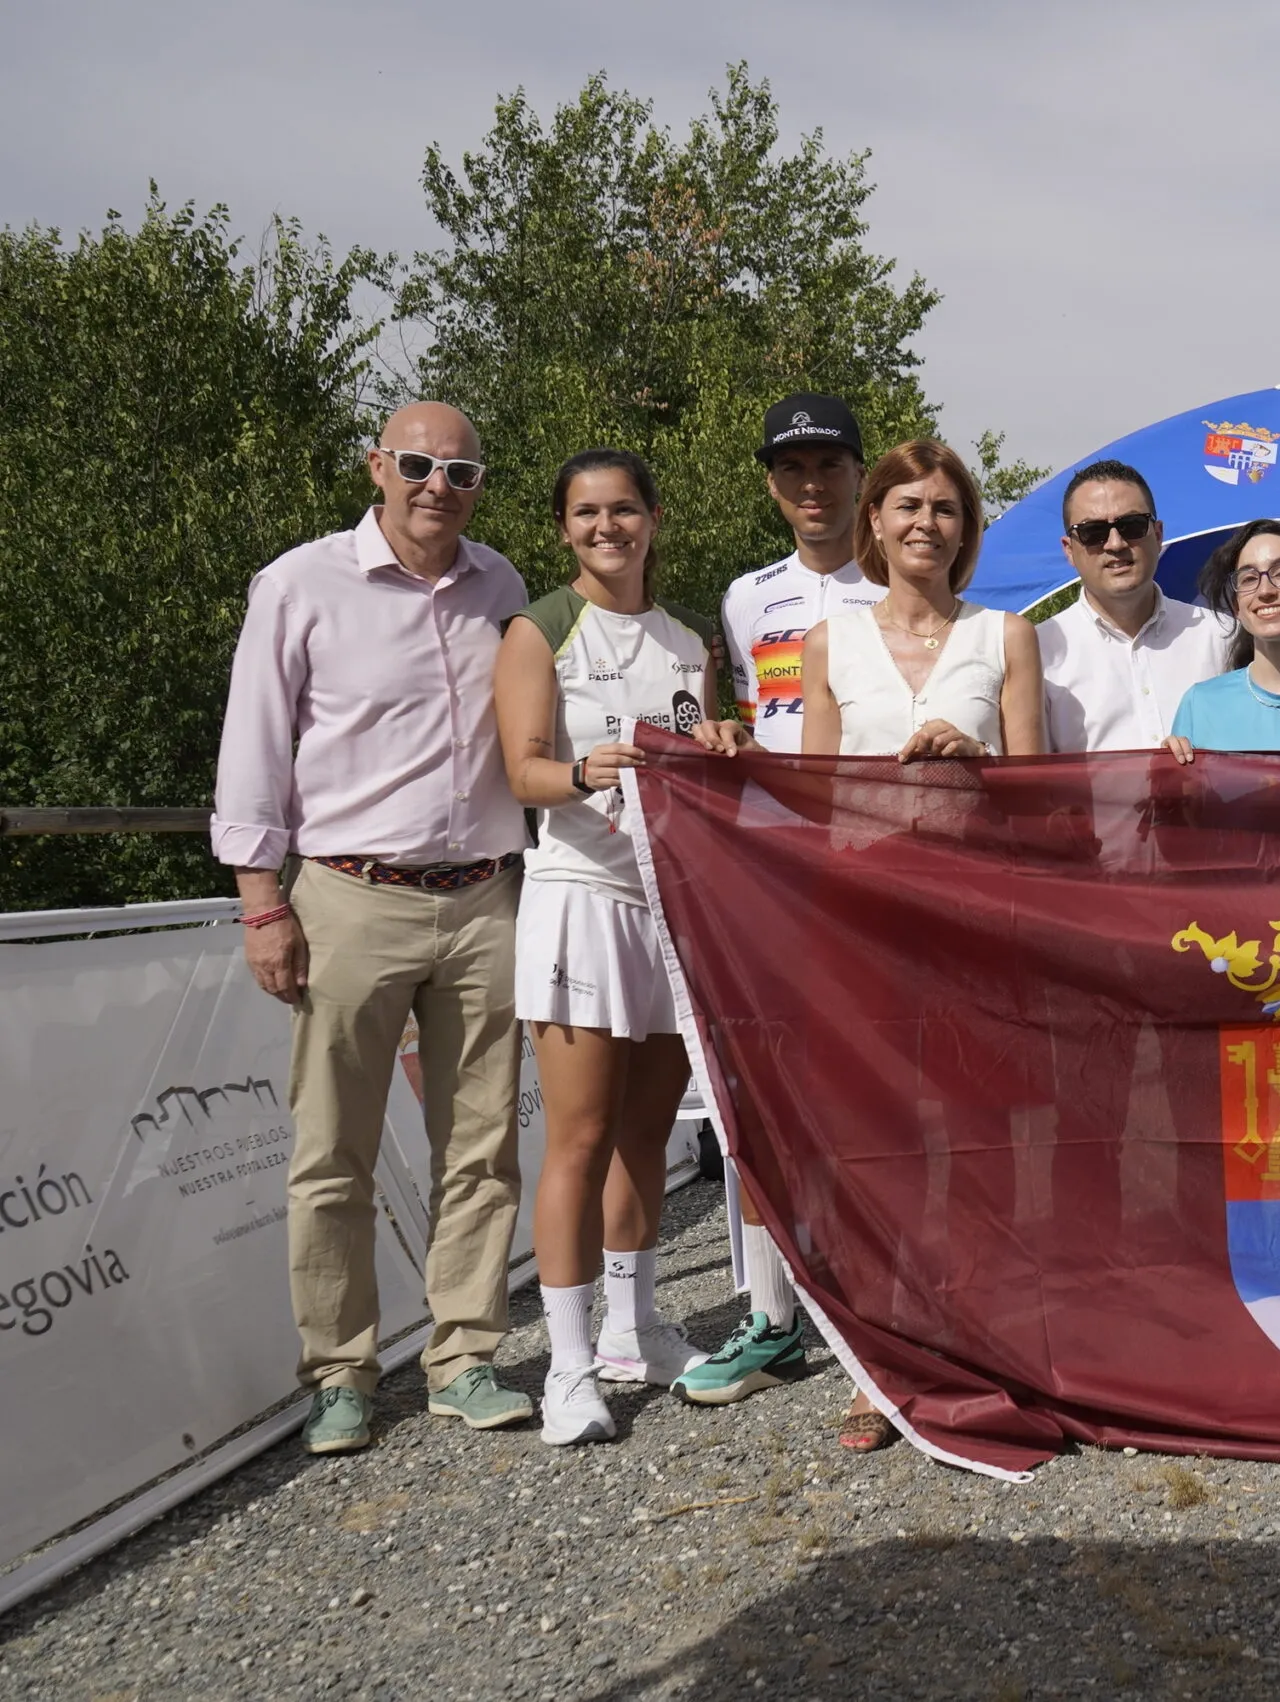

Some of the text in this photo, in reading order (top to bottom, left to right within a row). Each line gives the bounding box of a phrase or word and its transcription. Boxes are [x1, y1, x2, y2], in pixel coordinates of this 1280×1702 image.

[773, 428, 800, 444] MONTE
[755, 564, 788, 585] 226ERS
[759, 628, 806, 647] SC
[588, 672, 624, 681] PADEL
[763, 666, 802, 679] MONT
[157, 1142, 235, 1179] NUESTROS
[178, 1151, 289, 1199] NUESTRA FORTALEZA
[0, 1163, 94, 1234] ción
